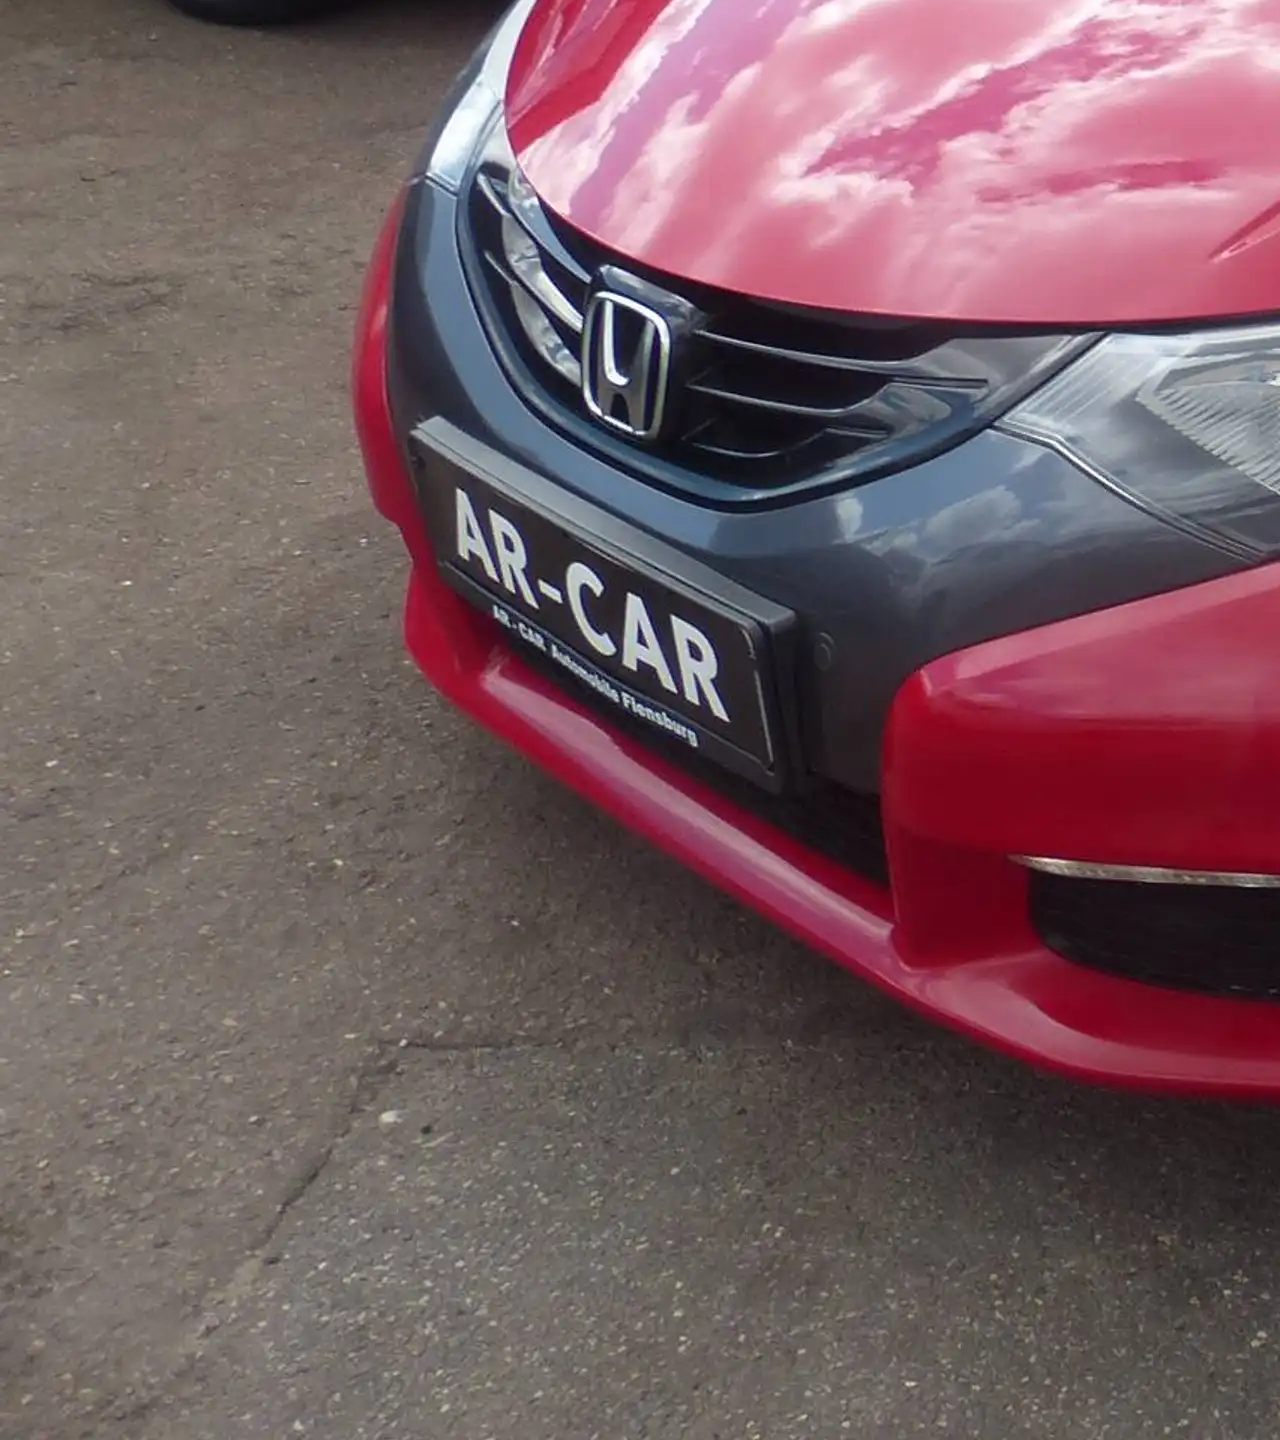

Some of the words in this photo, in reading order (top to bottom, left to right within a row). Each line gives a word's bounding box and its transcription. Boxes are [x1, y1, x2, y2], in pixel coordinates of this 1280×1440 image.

[454, 488, 731, 723] AR-CAR
[551, 643, 621, 704] Automobile
[623, 693, 699, 748] Flensburg
